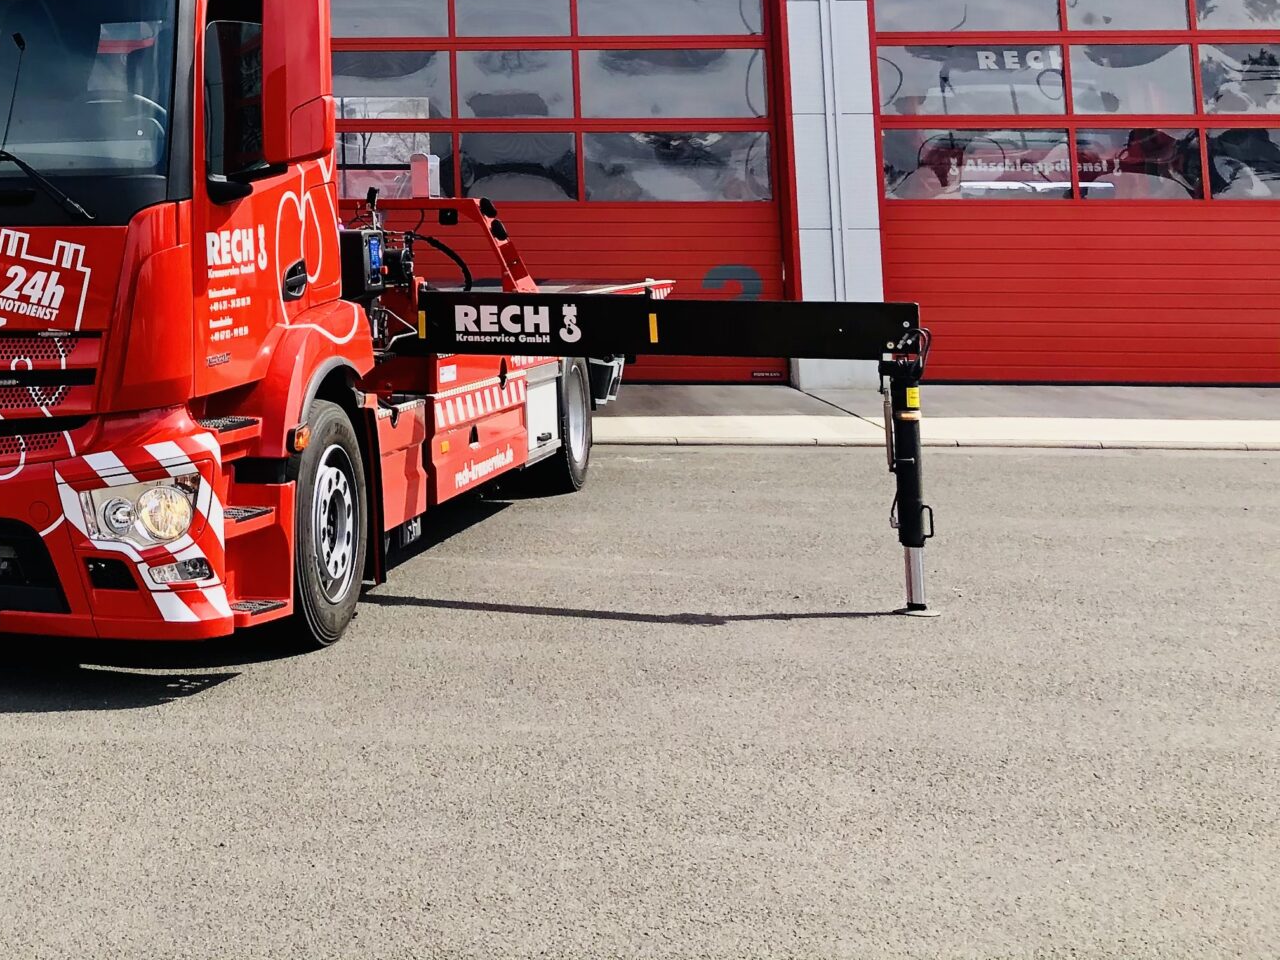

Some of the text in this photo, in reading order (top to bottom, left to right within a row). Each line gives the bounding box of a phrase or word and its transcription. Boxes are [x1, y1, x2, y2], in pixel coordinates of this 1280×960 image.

[206, 228, 255, 266] RECH
[0, 265, 65, 309] 24h
[454, 304, 550, 333] RECH
[456, 334, 551, 343] Kranservice GmbH
